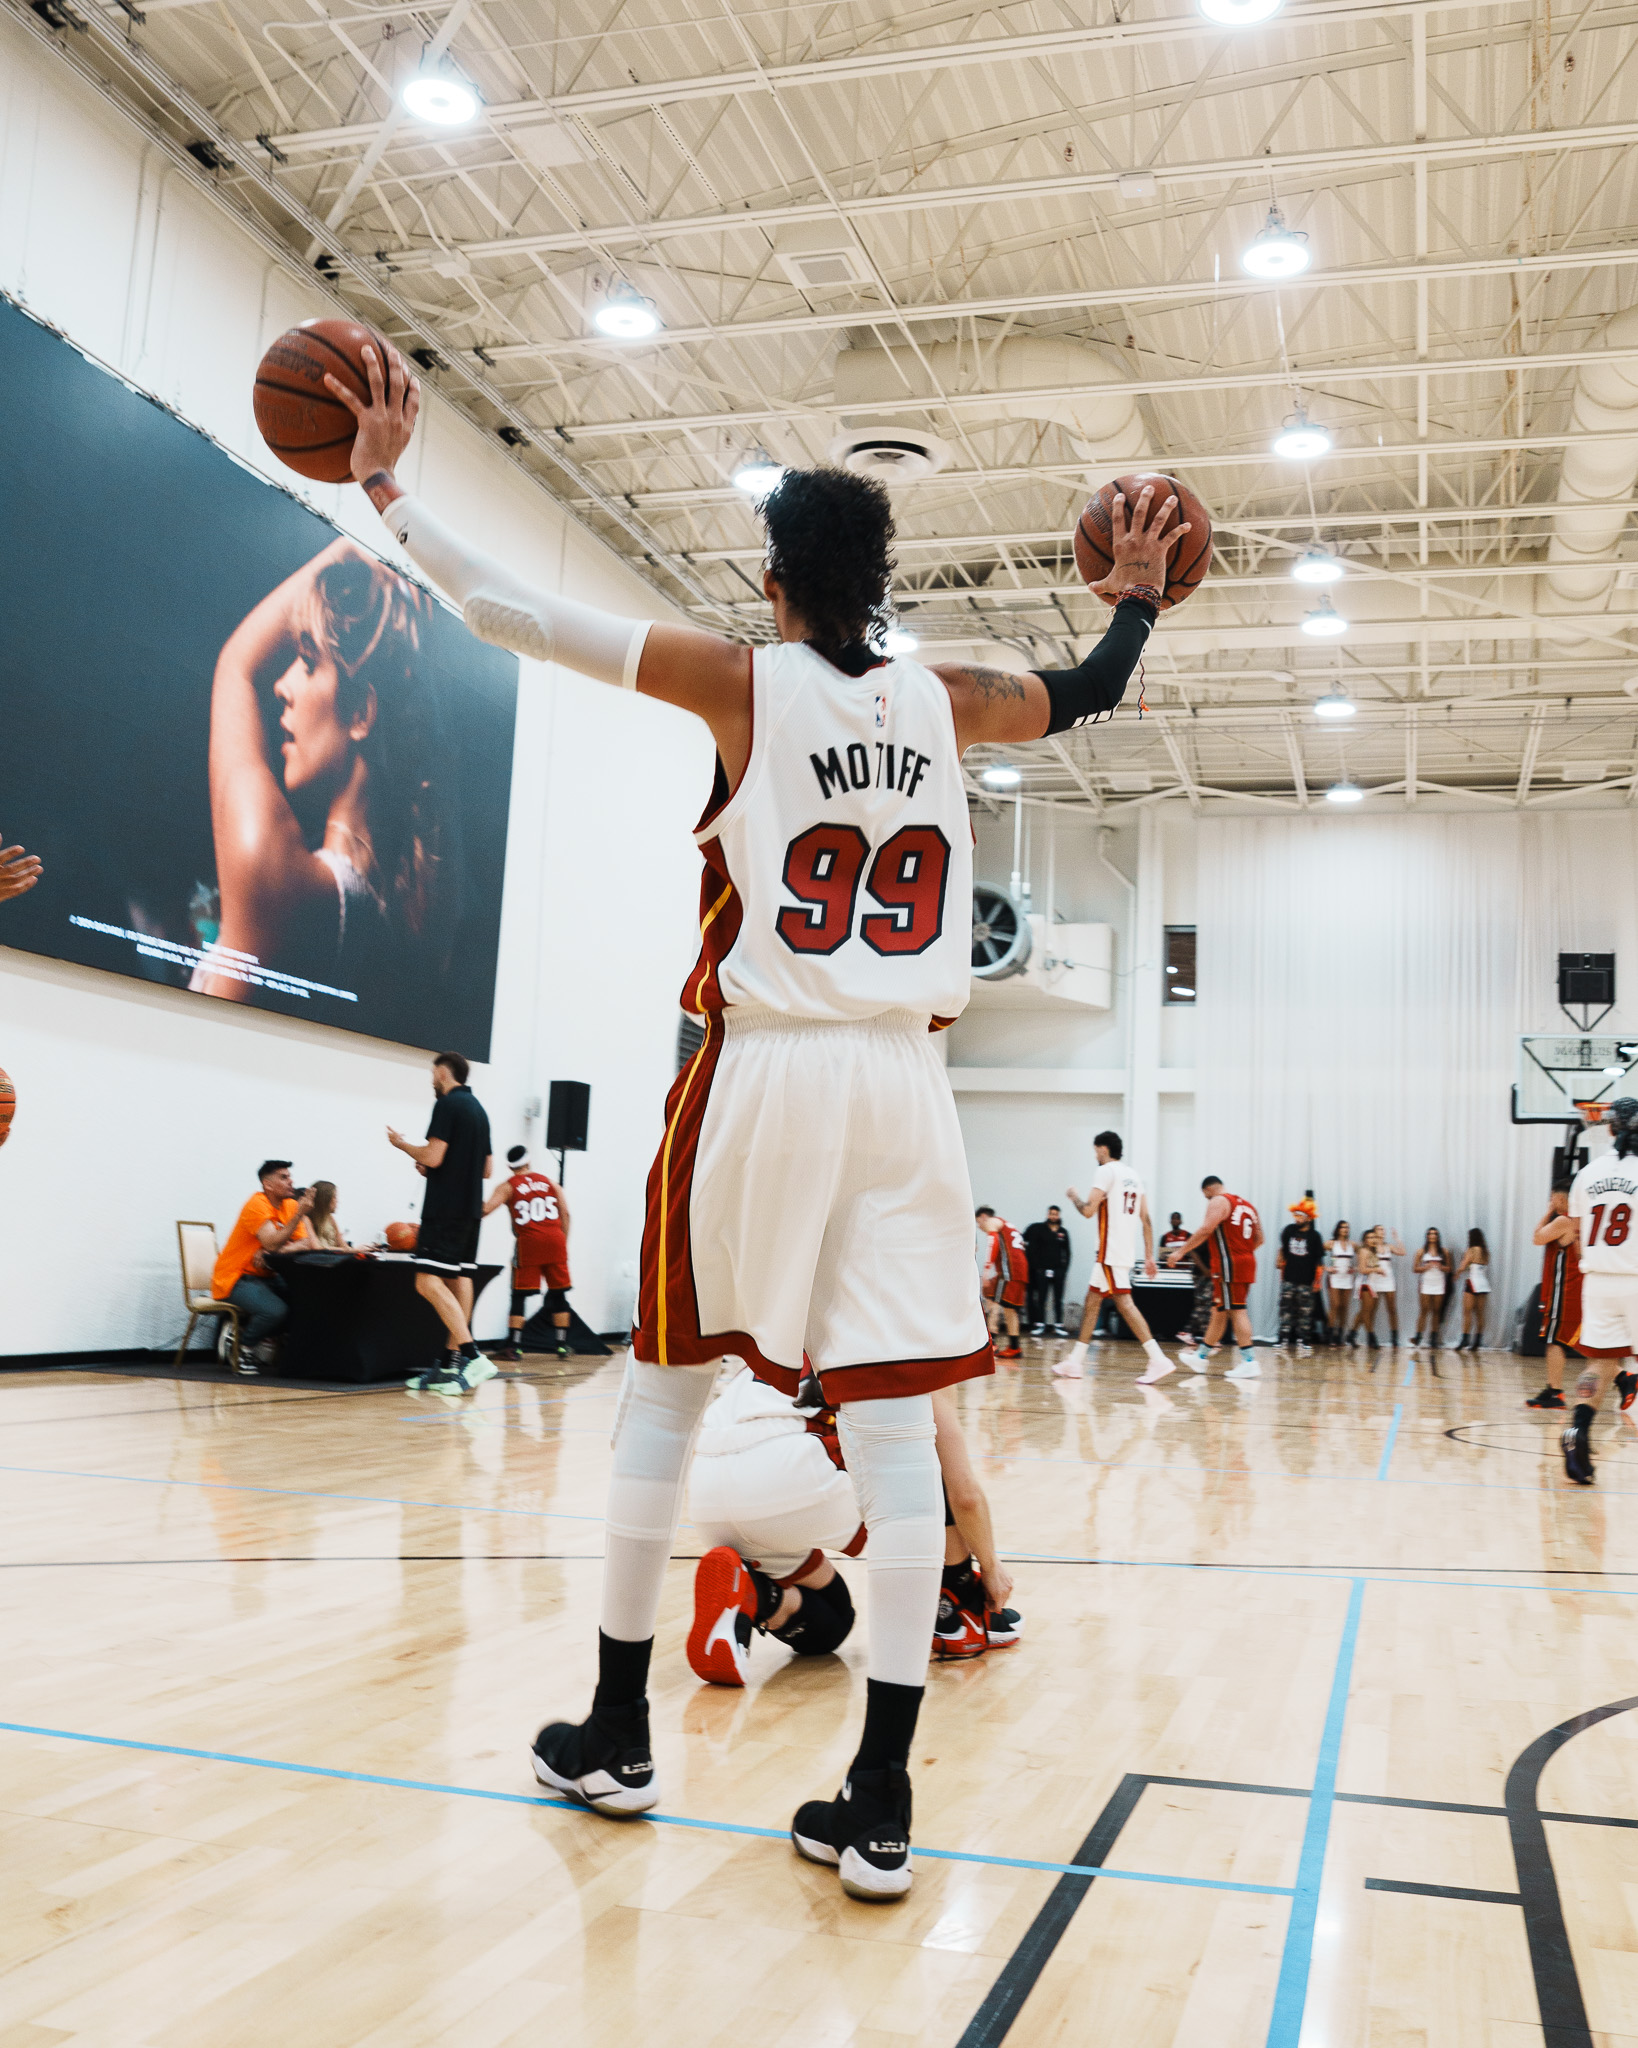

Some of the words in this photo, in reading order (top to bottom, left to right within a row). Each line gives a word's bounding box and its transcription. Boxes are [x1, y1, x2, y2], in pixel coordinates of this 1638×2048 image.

[809, 741, 931, 800] MOTIFF
[775, 822, 951, 957] 99
[514, 1195, 560, 1226] 305
[1242, 1217, 1253, 1240] 6
[1587, 1202, 1633, 1247] 18
